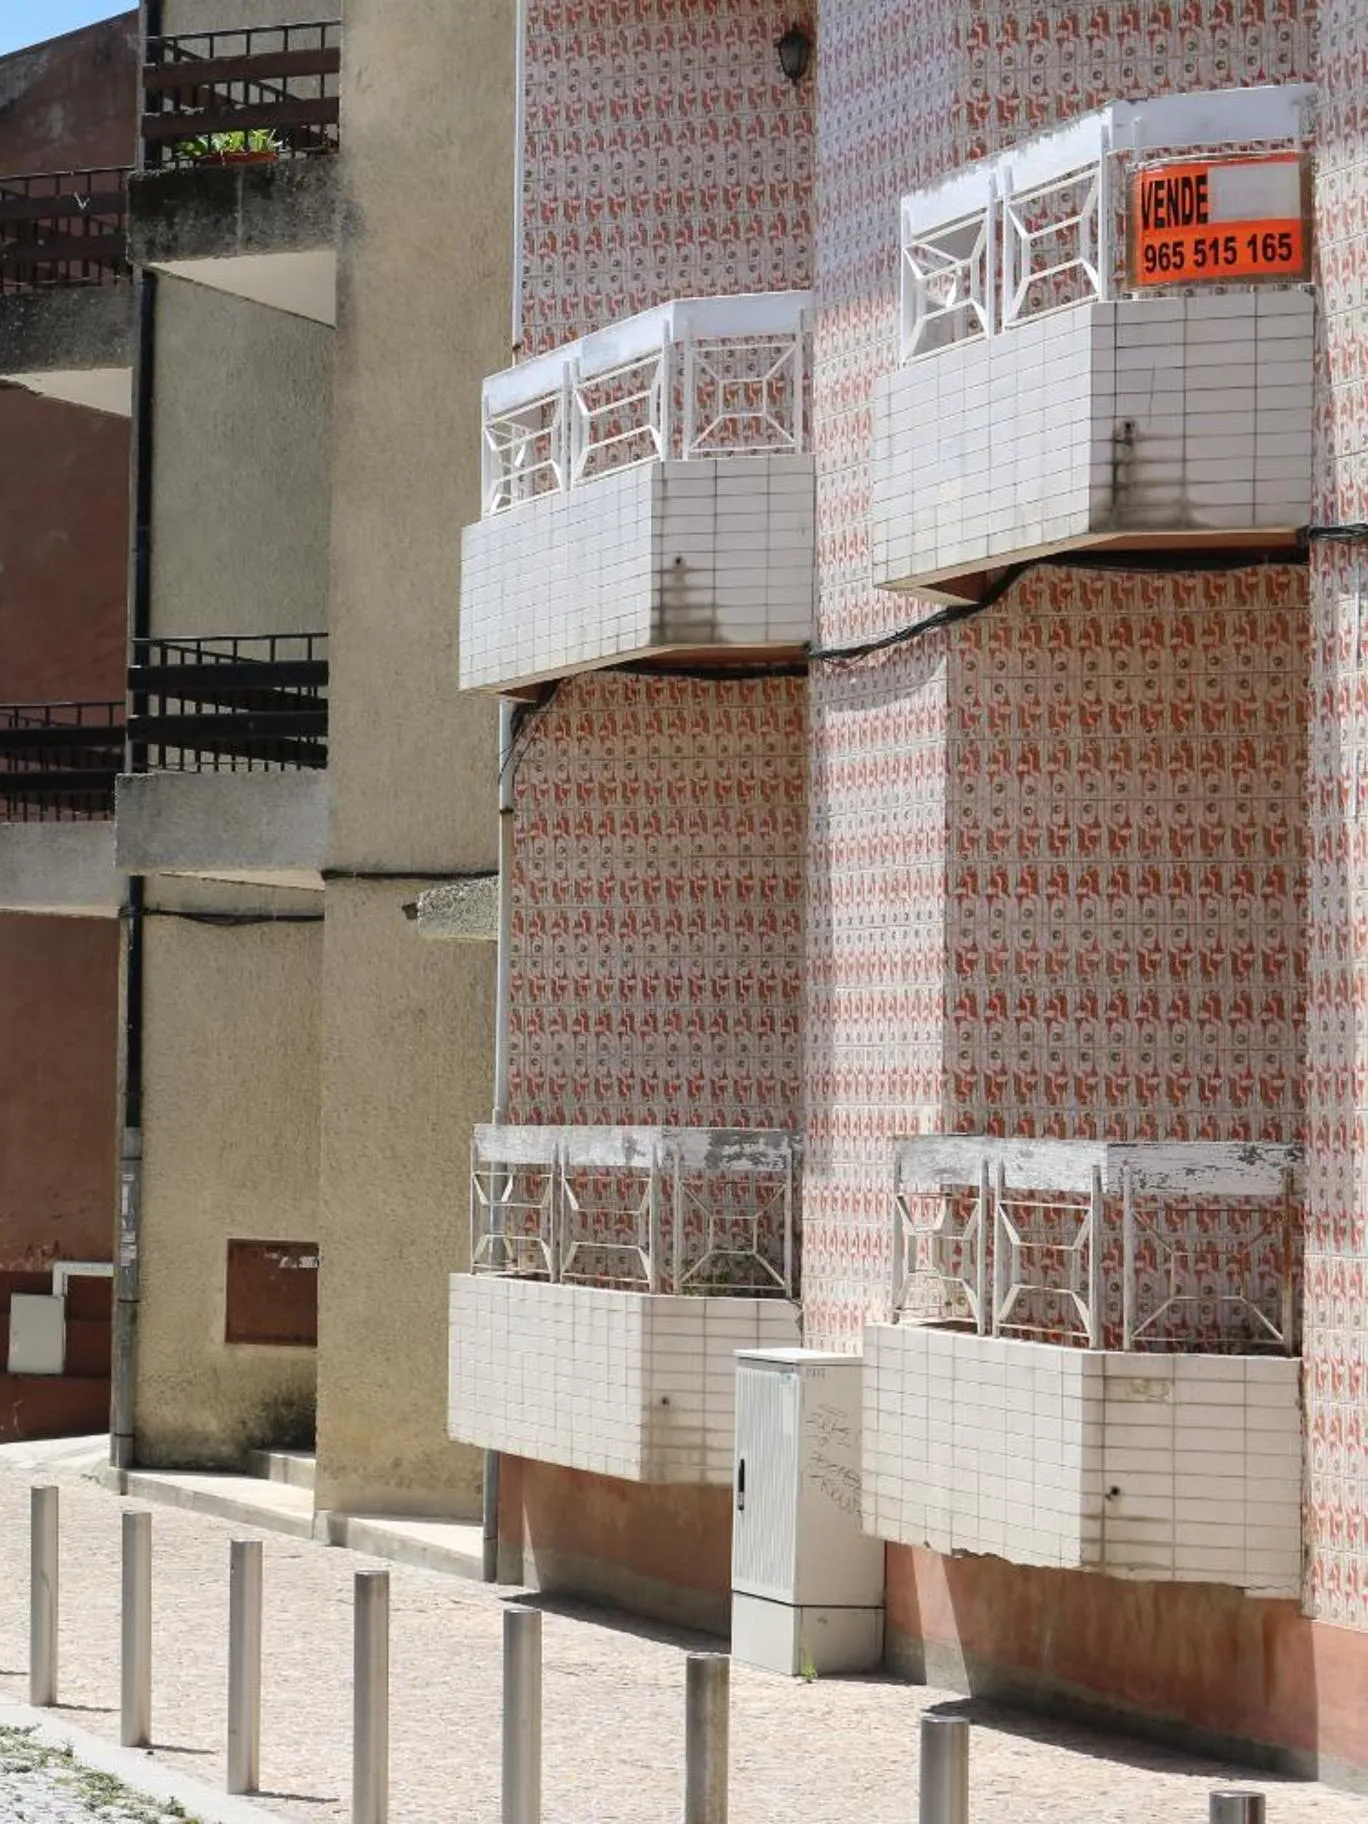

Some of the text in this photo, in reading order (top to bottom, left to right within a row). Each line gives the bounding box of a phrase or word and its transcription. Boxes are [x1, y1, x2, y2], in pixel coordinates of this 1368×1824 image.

[1141, 174, 1209, 231] VENDE
[1144, 232, 1293, 273] 965 515 165
